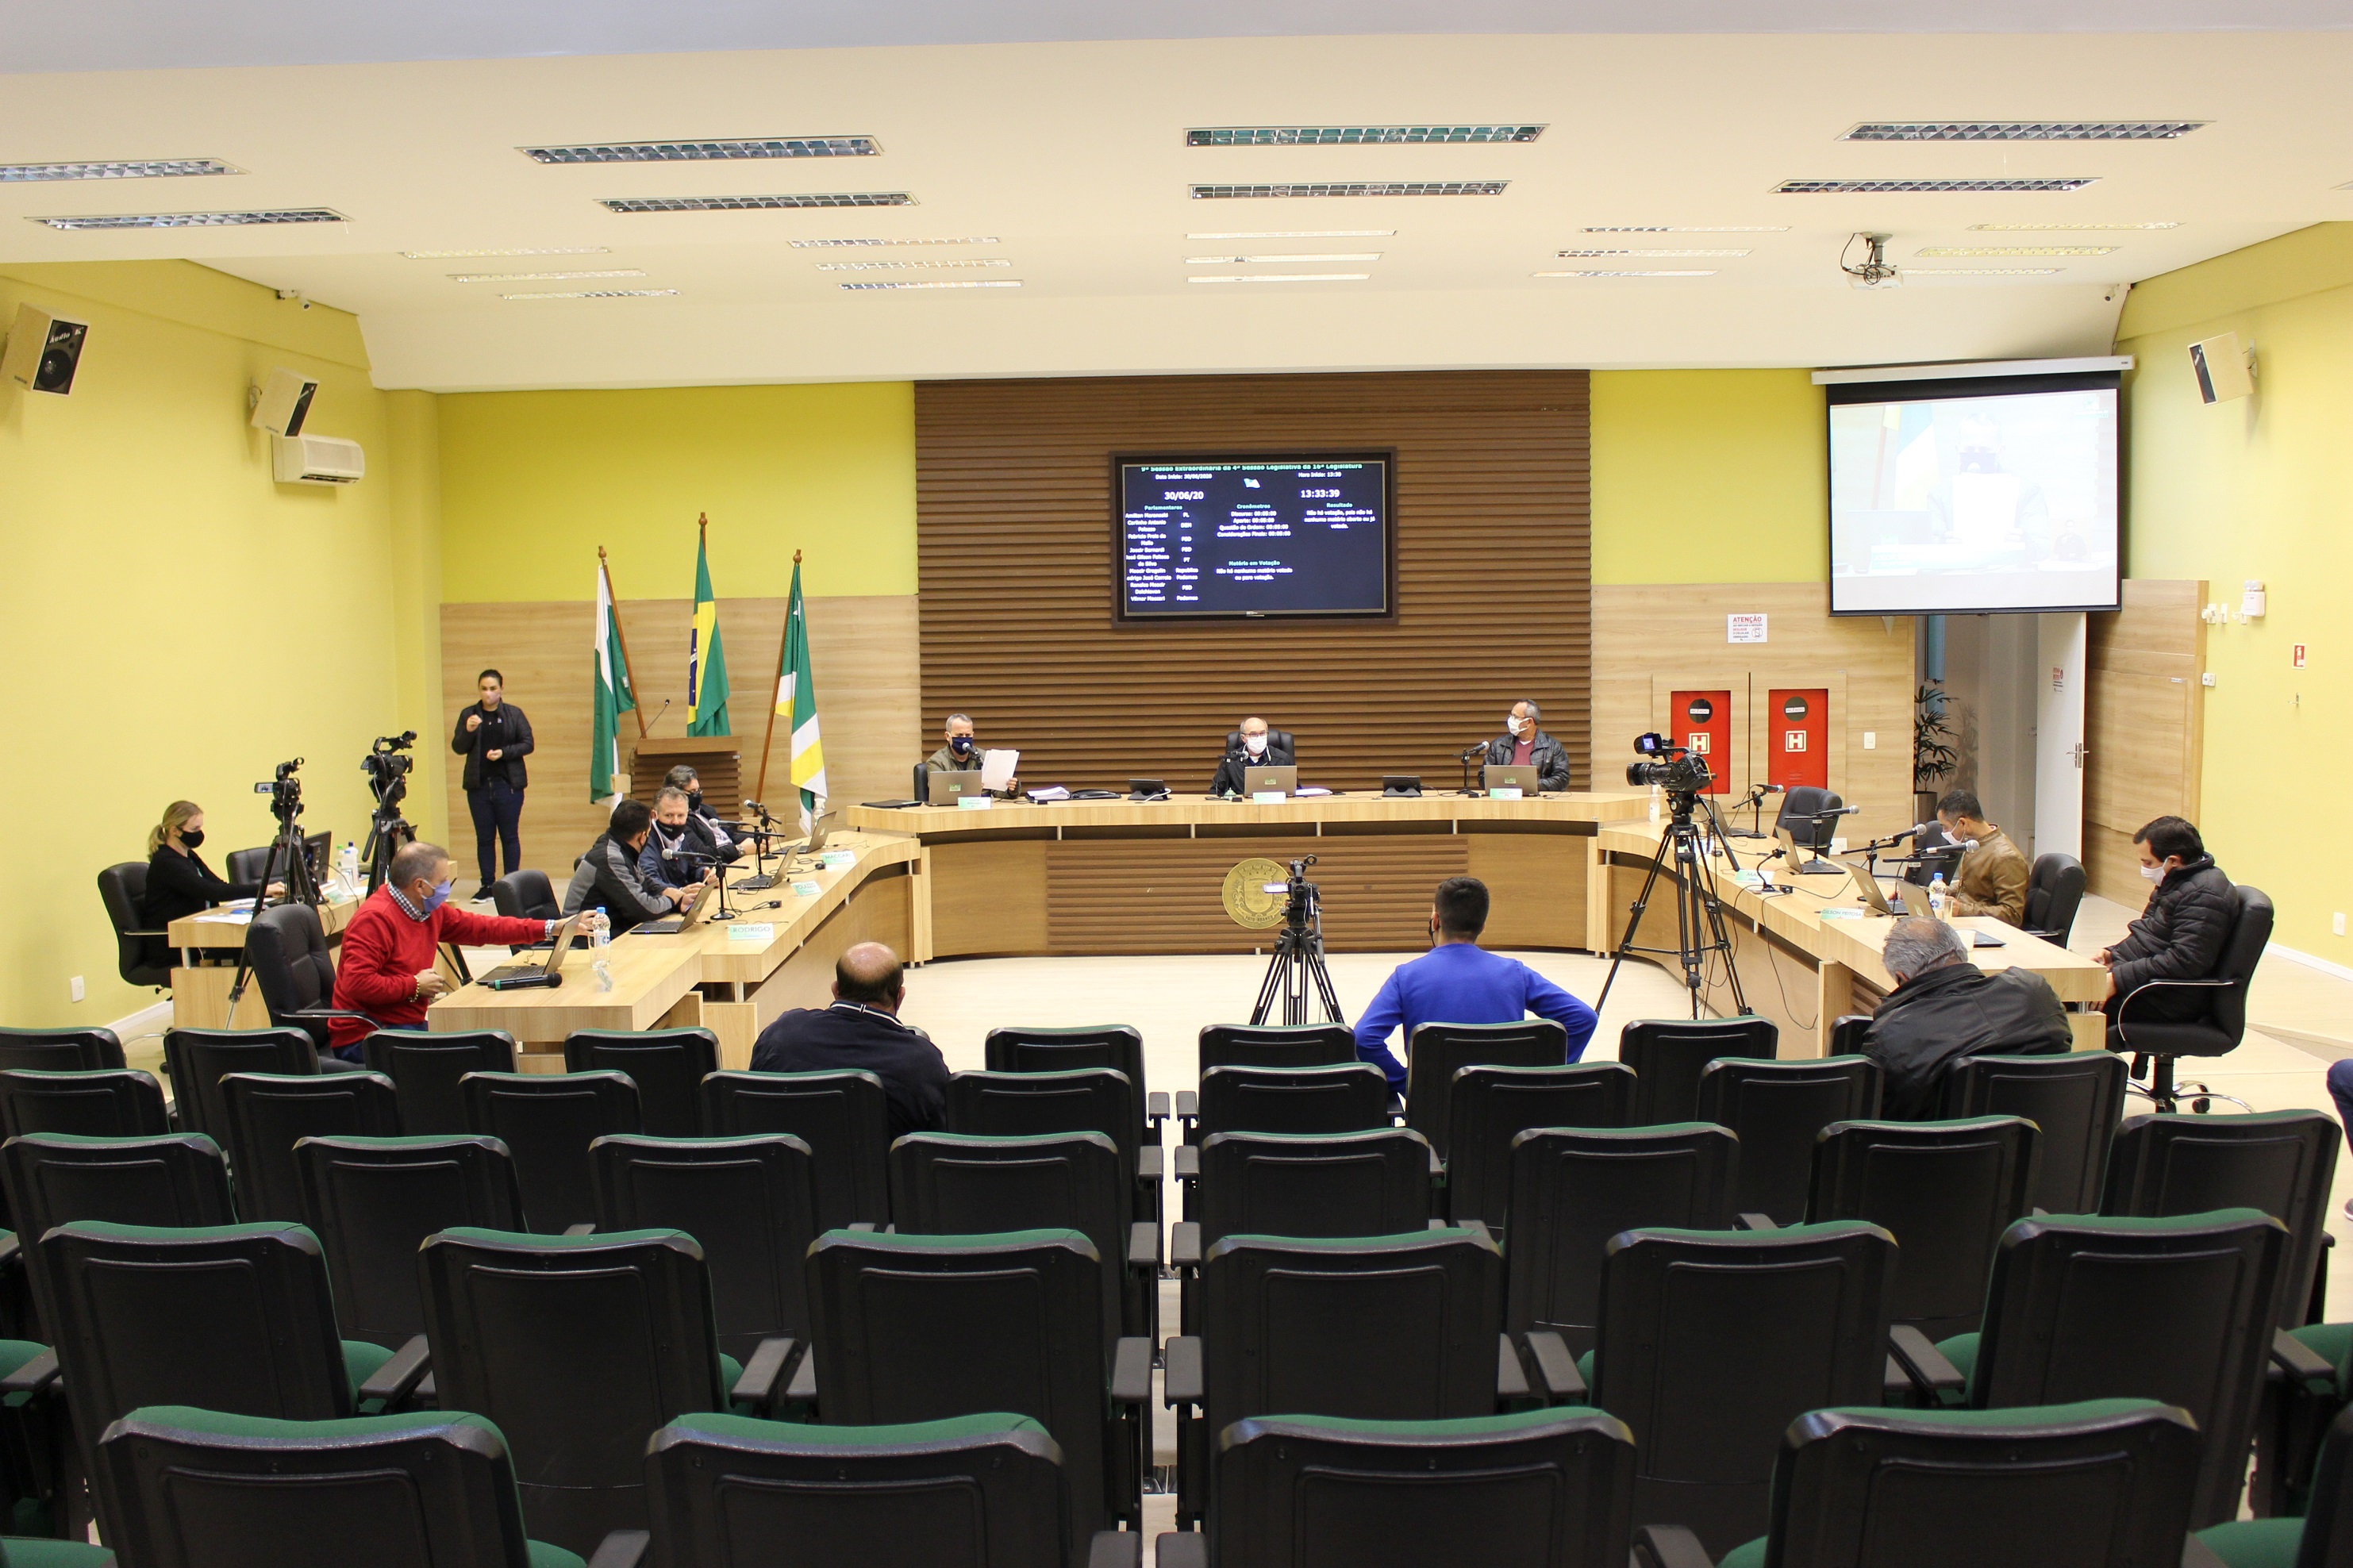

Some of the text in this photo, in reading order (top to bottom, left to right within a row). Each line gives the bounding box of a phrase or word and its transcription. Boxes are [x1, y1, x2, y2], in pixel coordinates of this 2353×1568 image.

[1164, 491, 1204, 501] 30/06/20
[1301, 489, 1340, 498] 13:33:39
[1733, 615, 1762, 624] ATENÇÃO
[1692, 736, 1705, 751] H
[1788, 734, 1803, 748] H
